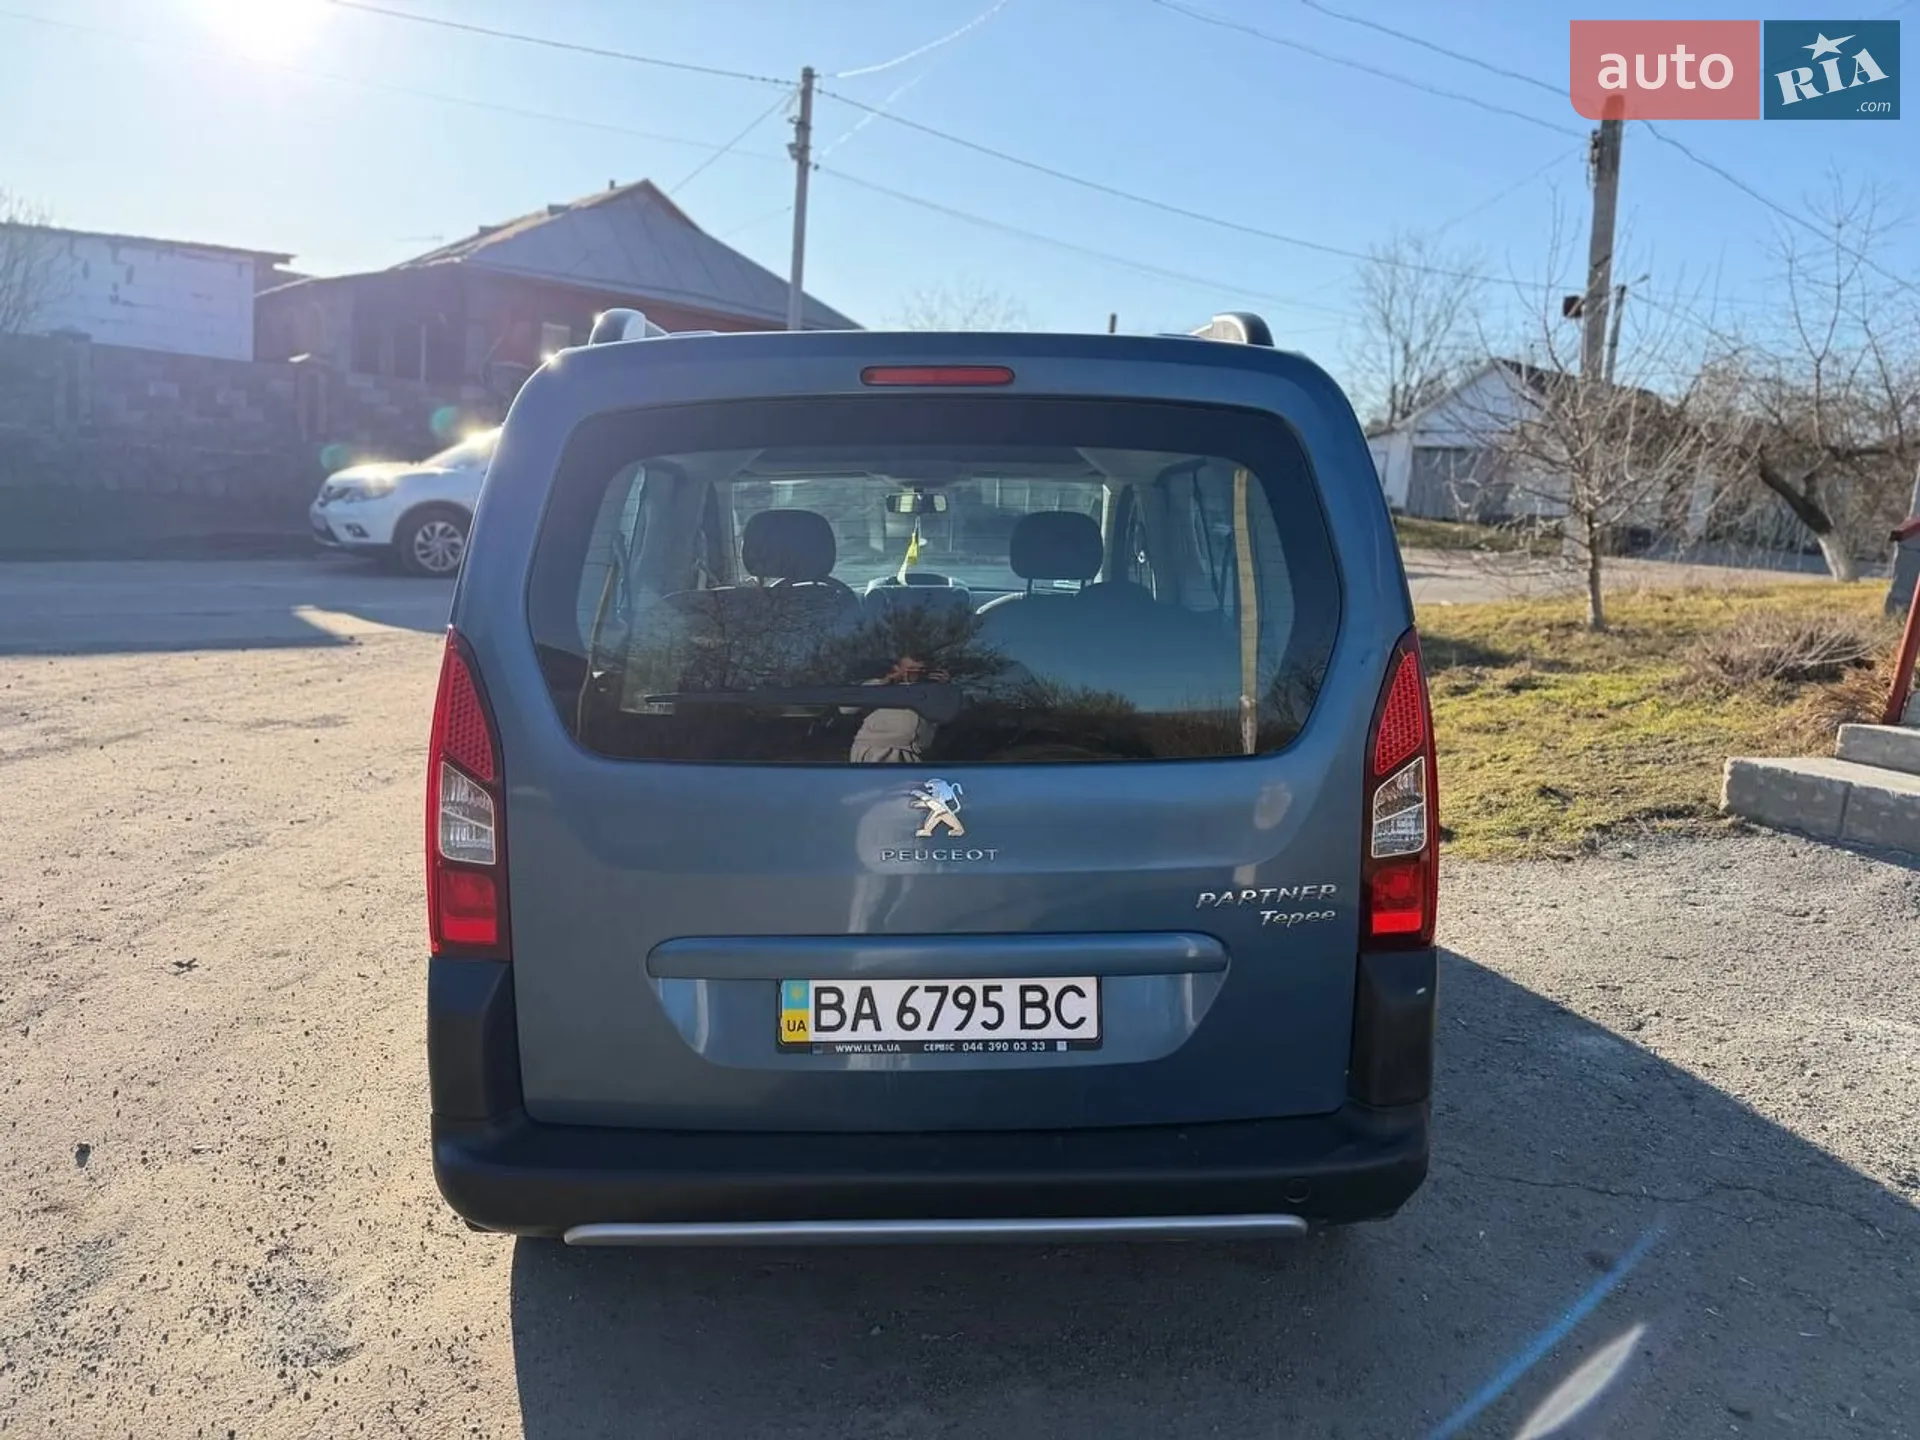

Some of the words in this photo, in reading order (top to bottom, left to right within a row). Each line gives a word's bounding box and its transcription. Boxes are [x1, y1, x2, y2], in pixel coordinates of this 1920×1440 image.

[880, 848, 999, 862] PEUGEOT
[1195, 883, 1338, 909] PARTNER
[1260, 909, 1336, 929] Tepee
[814, 985, 882, 1032] BA
[896, 984, 1005, 1031] 6795
[1019, 984, 1087, 1031] BC
[787, 1019, 807, 1033] UA
[835, 1043, 901, 1053] WWW.ILTA.UA
[962, 1042, 983, 1052] 044
[988, 1041, 1009, 1051] 390
[1013, 1041, 1028, 1051] 03
[1031, 1041, 1046, 1051] 33
